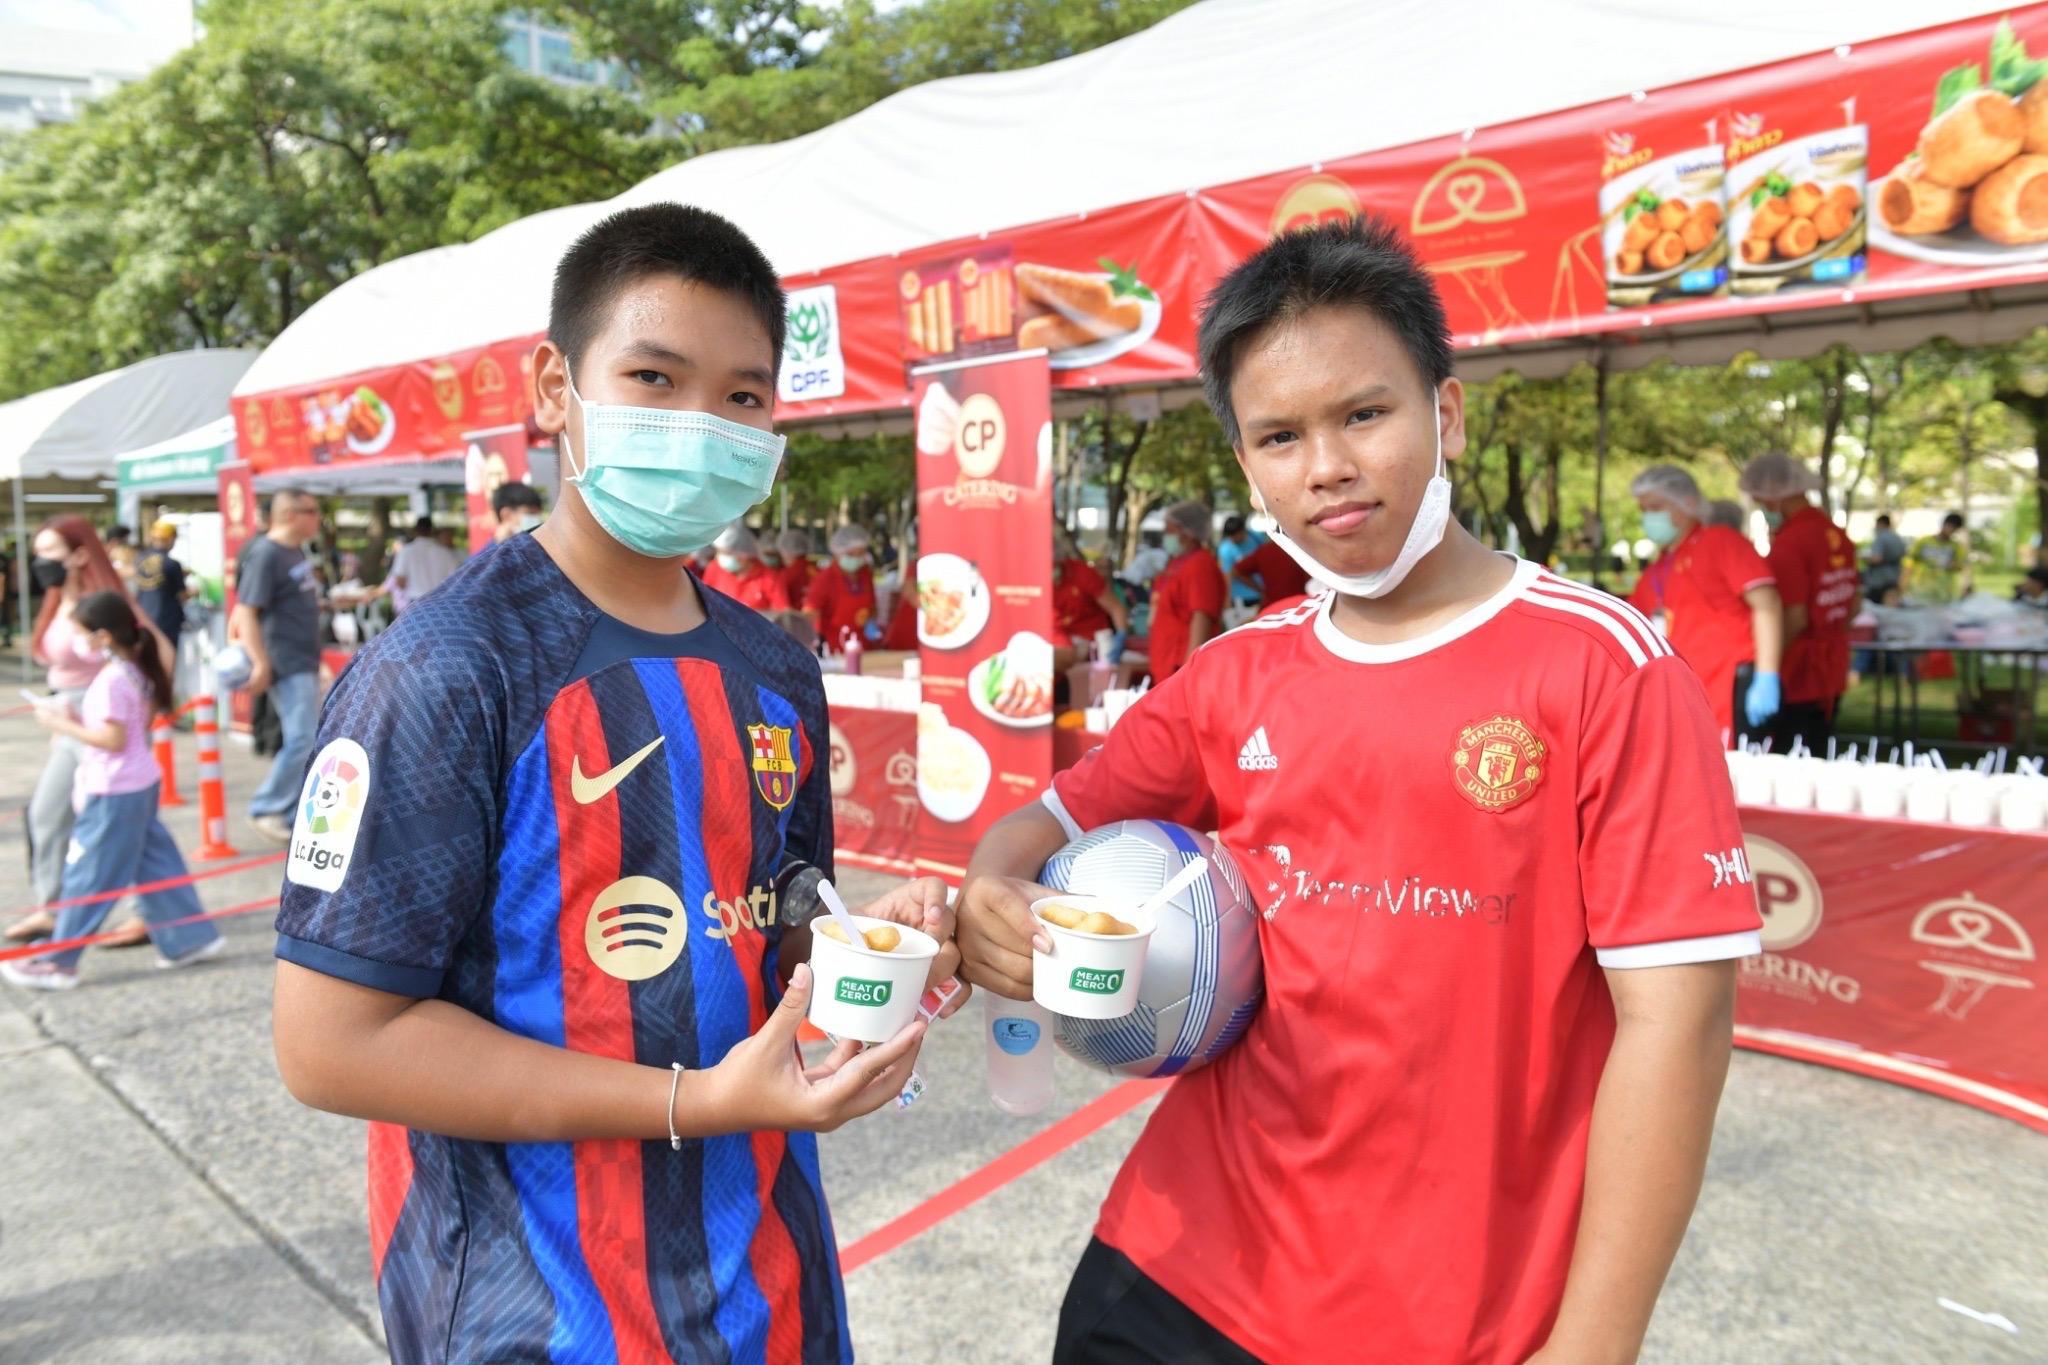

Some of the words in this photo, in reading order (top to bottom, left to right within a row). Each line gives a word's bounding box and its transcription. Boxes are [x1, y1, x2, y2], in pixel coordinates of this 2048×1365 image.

[791, 369, 830, 392] CPF
[962, 420, 996, 452] CP
[1466, 724, 1537, 761] MANCHESTER
[767, 759, 782, 771] FCB
[1237, 754, 1278, 770] adidas
[1467, 780, 1517, 801] UNITED
[1756, 872, 1800, 916] P
[703, 877, 777, 948] Spoti
[841, 980, 872, 993] MEAT
[1075, 978, 1105, 990] ZERO
[1076, 970, 1107, 982] MEAT
[1741, 953, 1862, 1005] ERING
[840, 988, 871, 1001] ZERO
